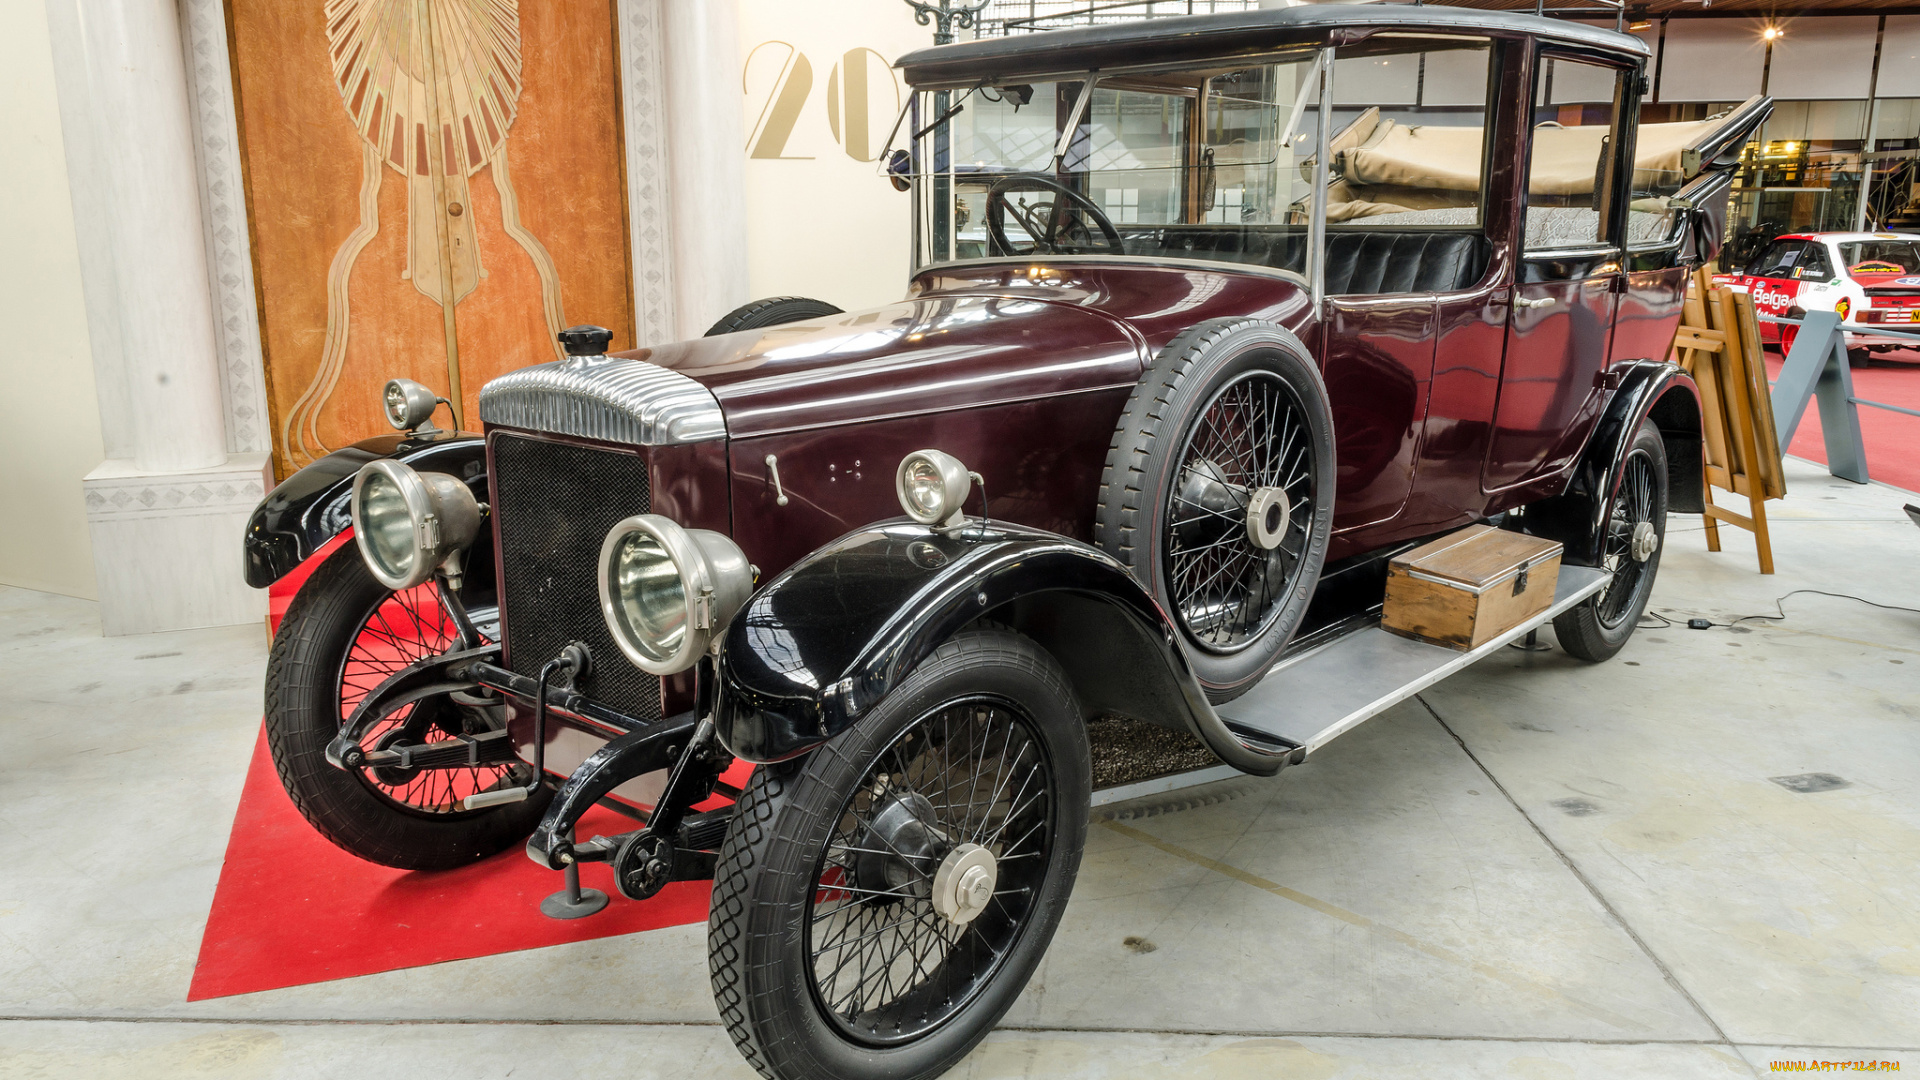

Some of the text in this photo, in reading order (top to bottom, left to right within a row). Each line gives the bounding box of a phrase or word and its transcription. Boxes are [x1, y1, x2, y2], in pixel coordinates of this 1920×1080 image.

[742, 40, 900, 163] 20
[1753, 288, 1790, 310] Belga
[1264, 506, 1330, 654] INDIA CORD
[314, 726, 408, 840] MICHELN
